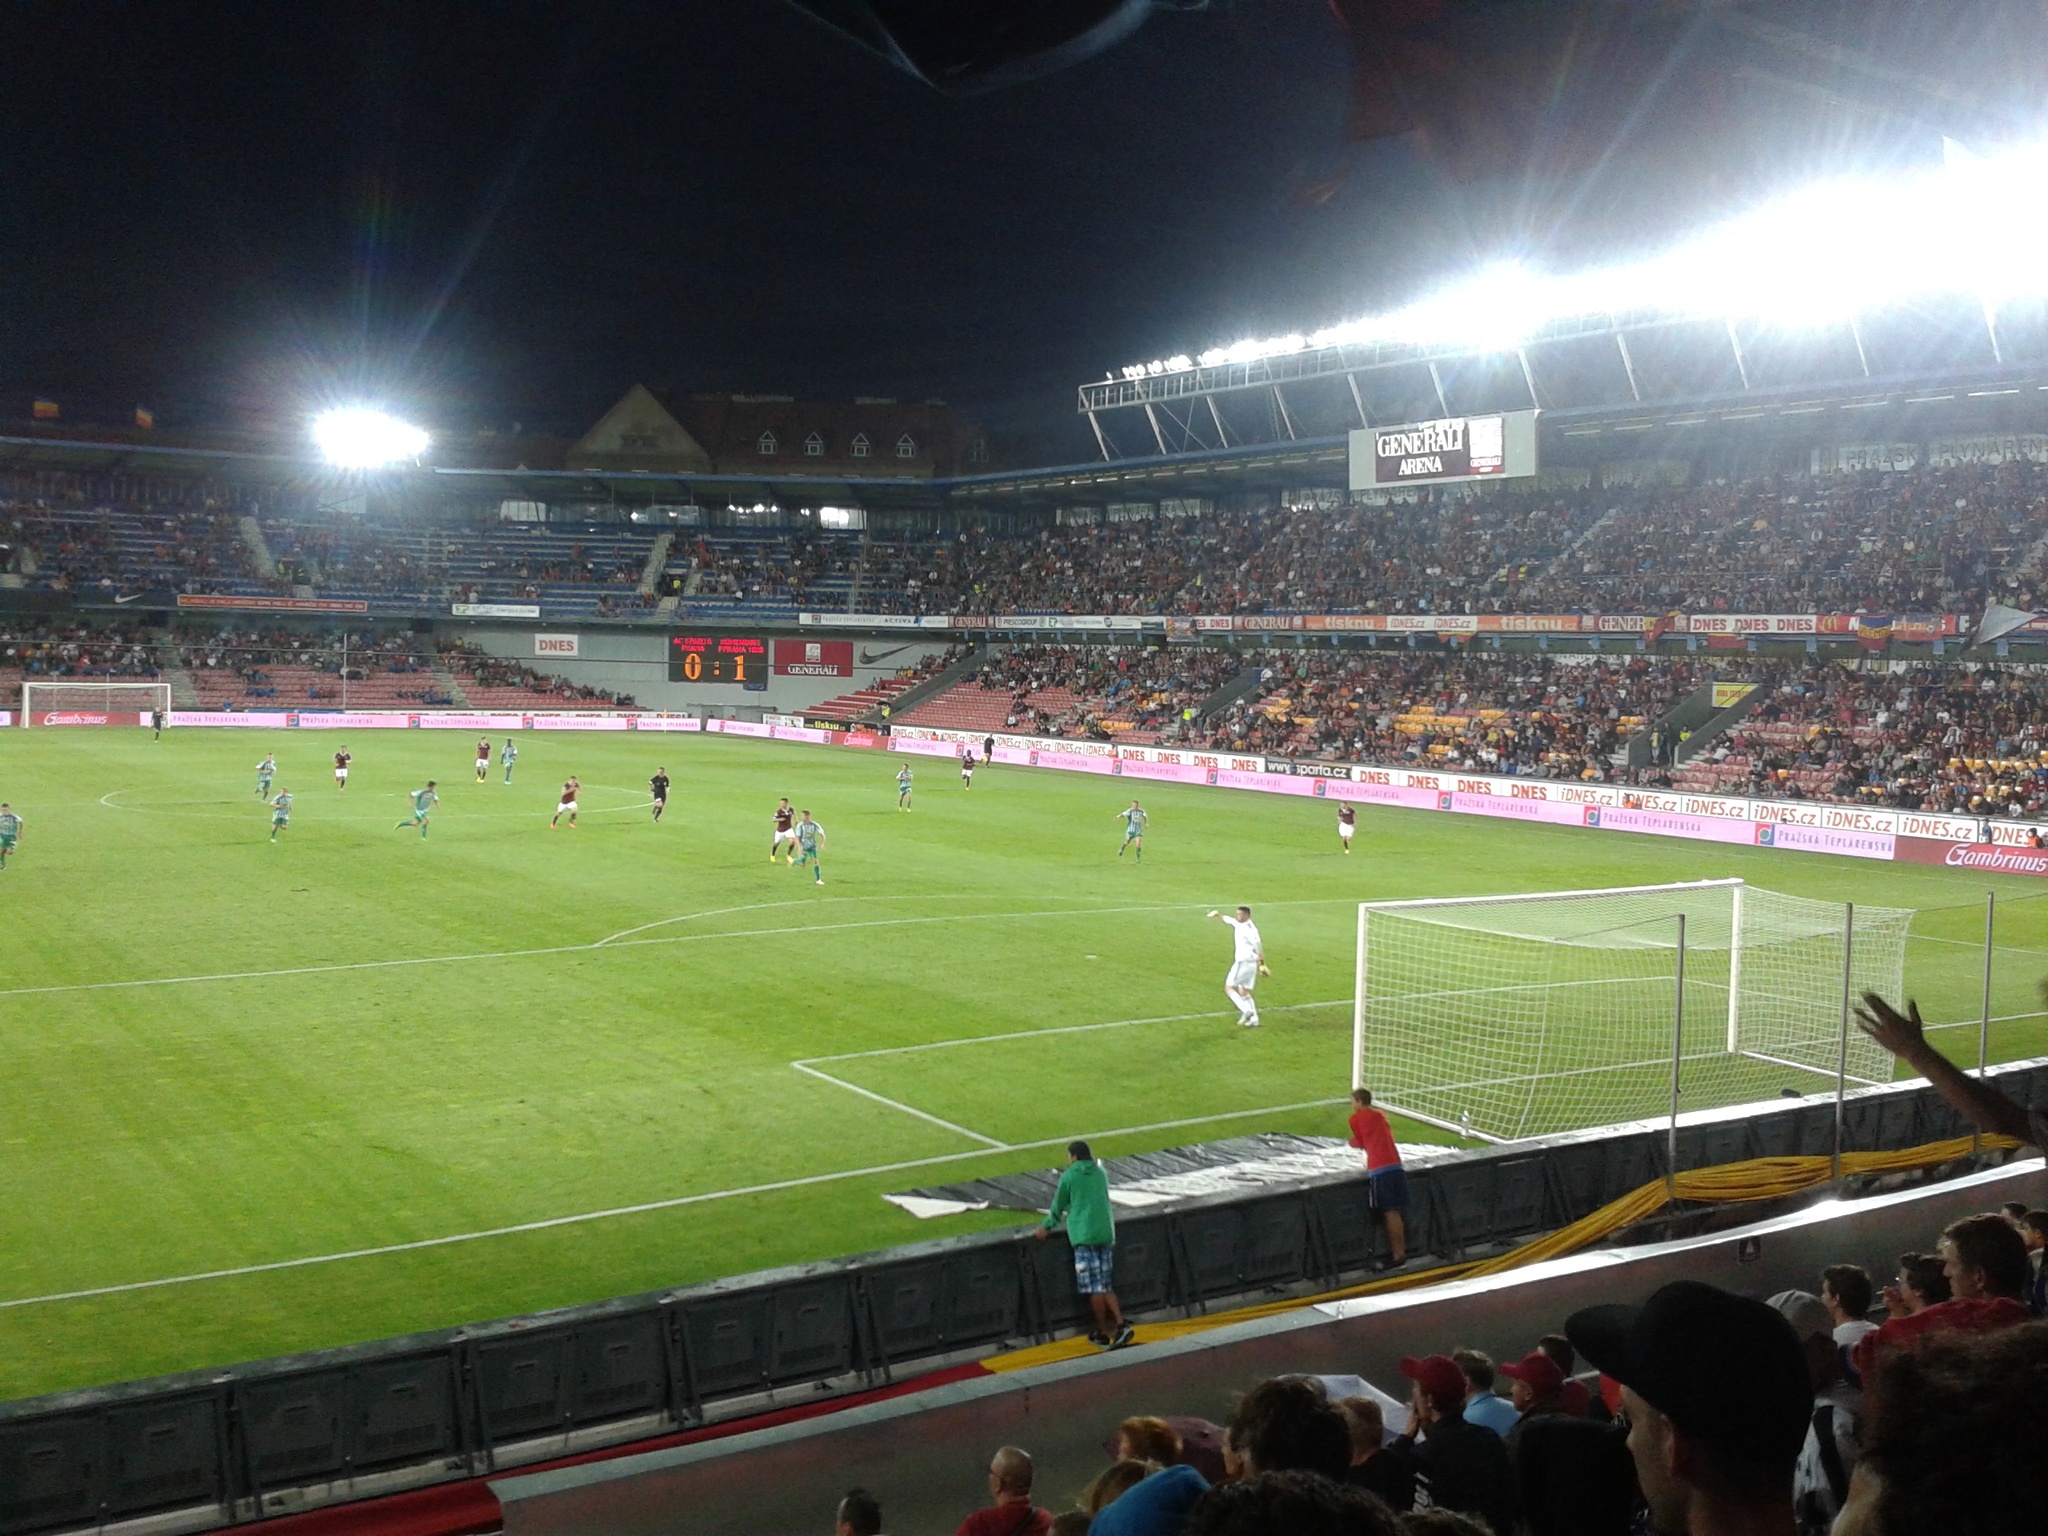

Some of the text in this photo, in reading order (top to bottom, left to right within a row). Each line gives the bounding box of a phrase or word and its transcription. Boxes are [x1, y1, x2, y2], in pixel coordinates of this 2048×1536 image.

[1377, 424, 1465, 457] GENERALI
[1399, 456, 1443, 476] ARENA
[955, 616, 986, 627] GENERALI
[1244, 616, 1289, 630] GENERALI
[1692, 618, 1813, 632] DNES DNES DNES
[539, 639, 575, 653] DNES
[684, 653, 702, 680] 0
[733, 655, 747, 681] 1
[787, 663, 838, 675] GENERALI
[43, 711, 108, 726] Gambrinus
[1122, 749, 1257, 772] DNES DNES DNES DNES
[1267, 761, 1347, 778] wwwsparta.cz
[1359, 770, 1548, 801] DNES DNES DNES DNES
[1561, 788, 1613, 806] iDNES.cz
[1685, 799, 1744, 818] iDNES.cz
[1754, 804, 1817, 826] iDNES.cz
[1826, 810, 1893, 833] iDNES.cz
[1903, 817, 1973, 840] iDNES.cz
[1945, 843, 2047, 873] Gambrinus
